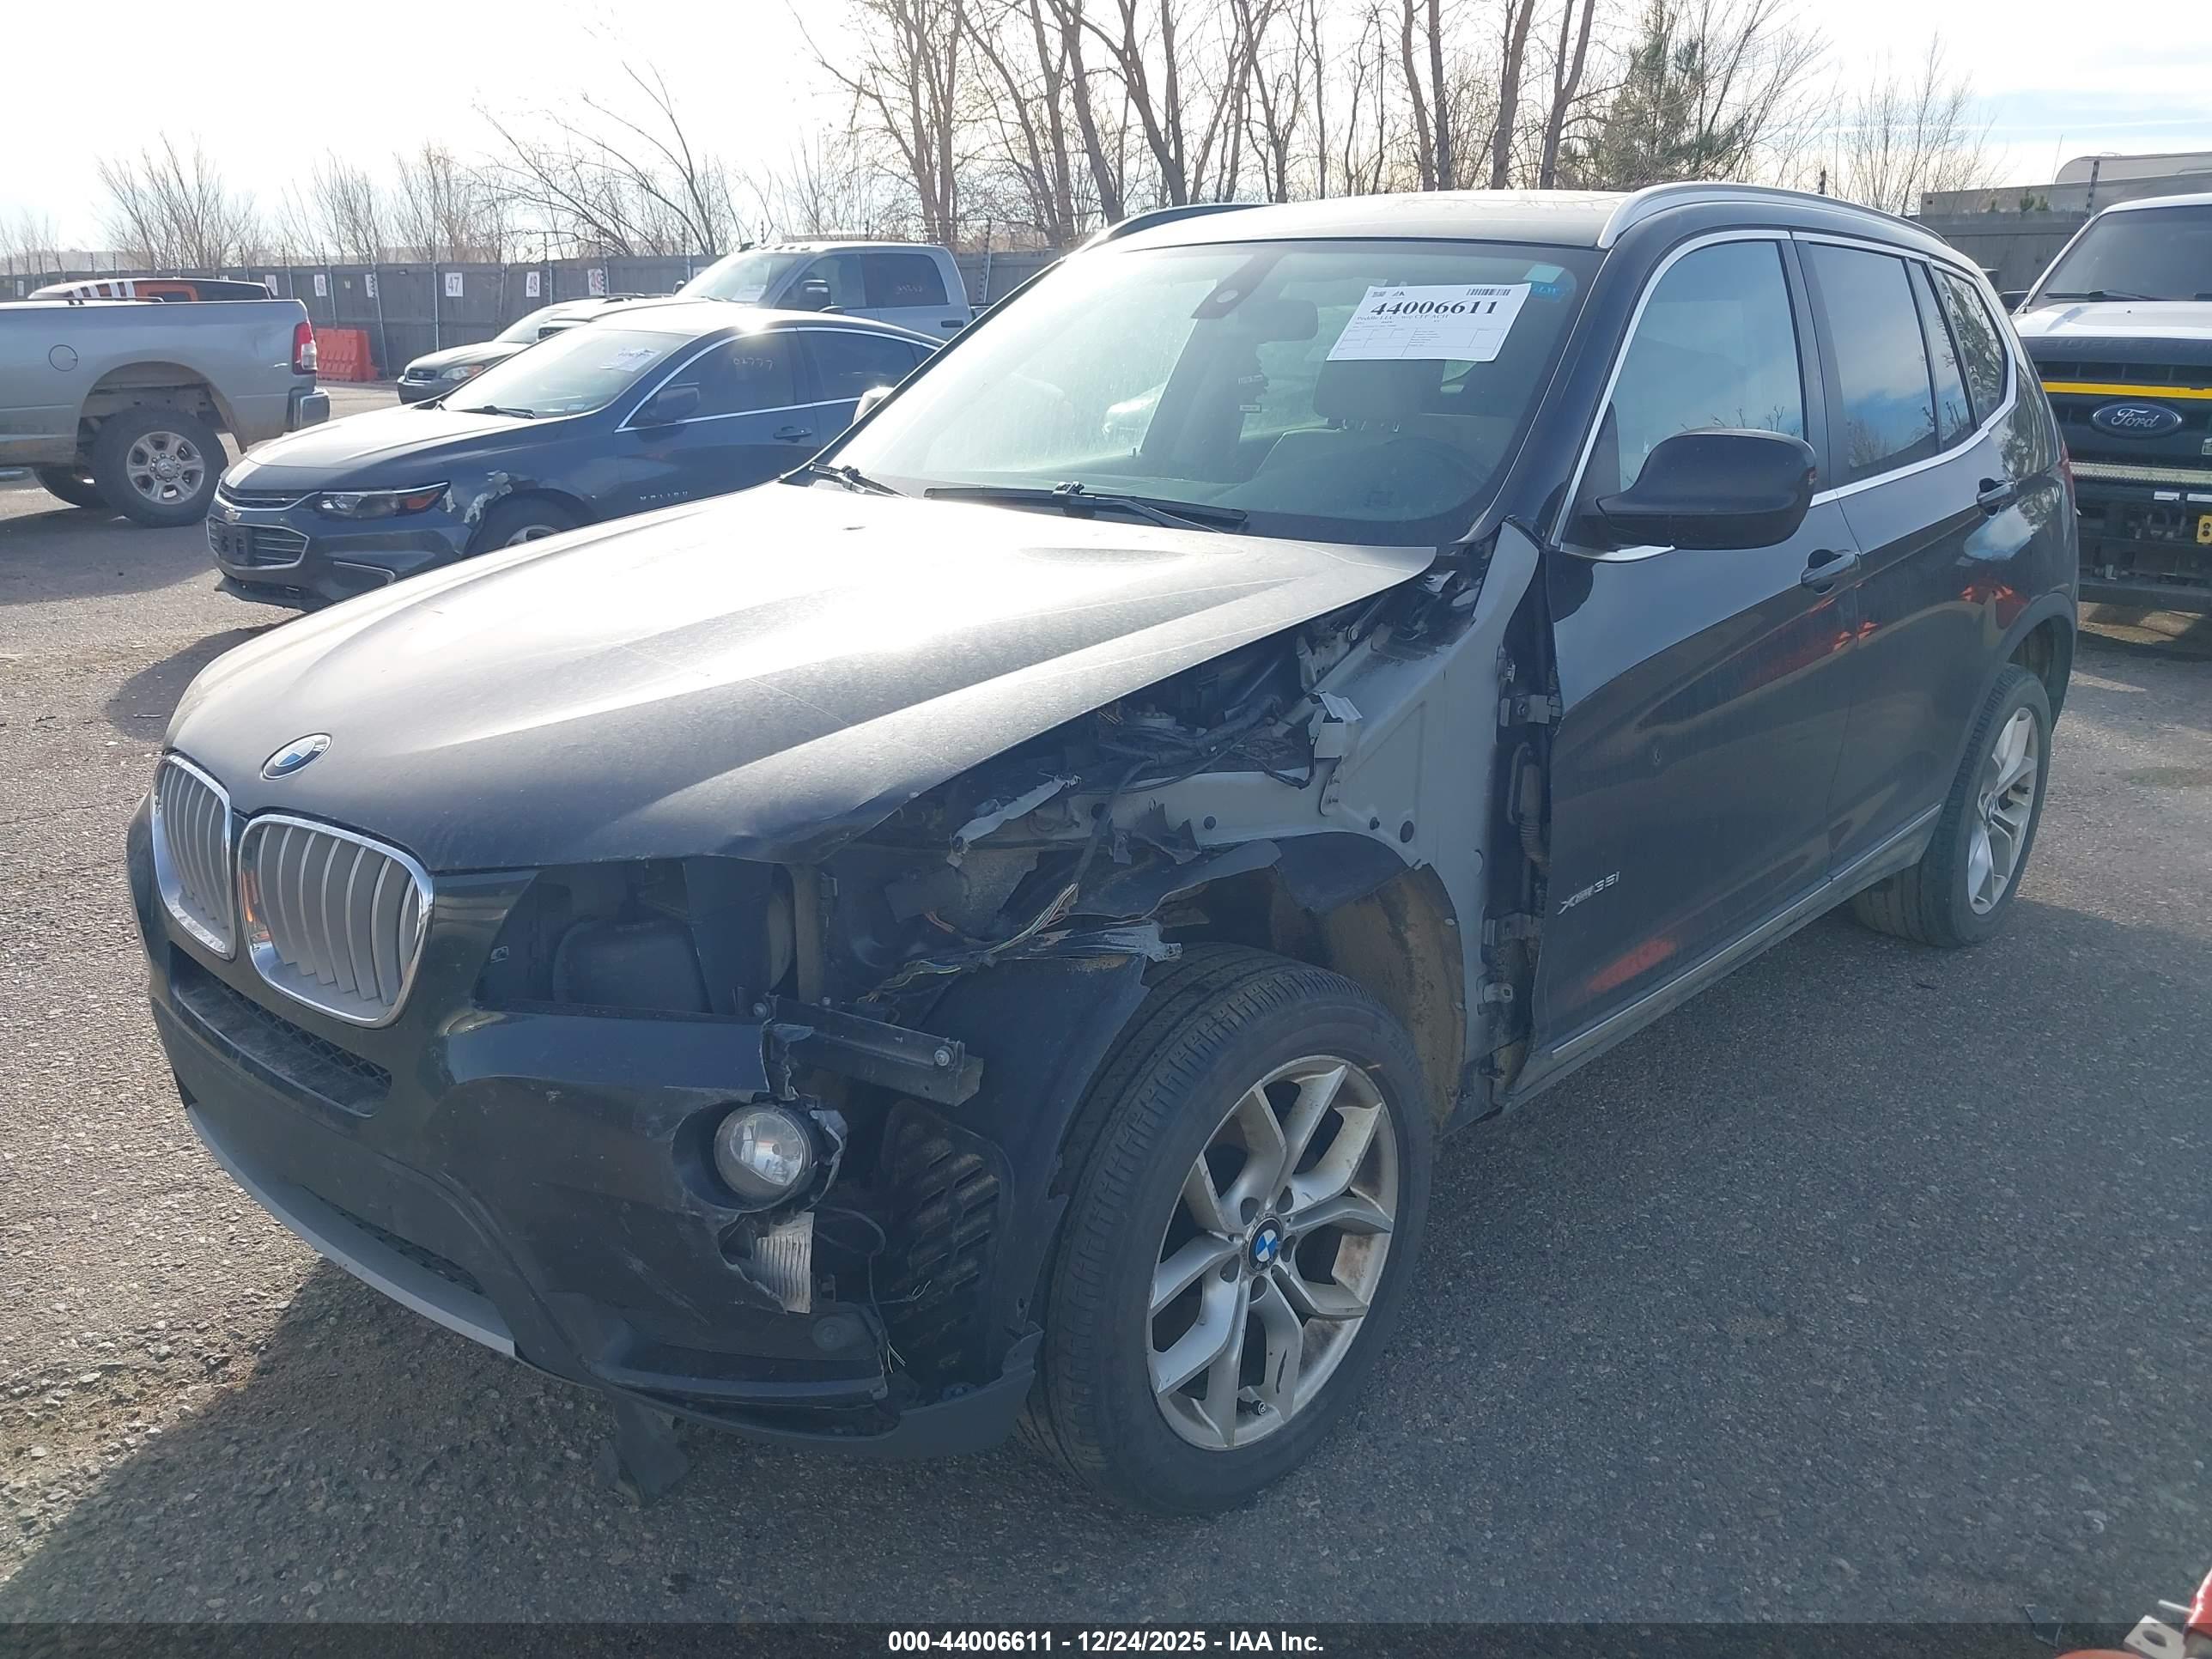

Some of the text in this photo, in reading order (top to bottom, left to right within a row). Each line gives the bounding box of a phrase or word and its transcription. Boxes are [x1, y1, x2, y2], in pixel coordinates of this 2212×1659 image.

[447, 276, 459, 292] 47
[527, 276, 537, 292] 48
[1370, 301, 1498, 315] 44006611
[2111, 408, 2160, 428] Ford
